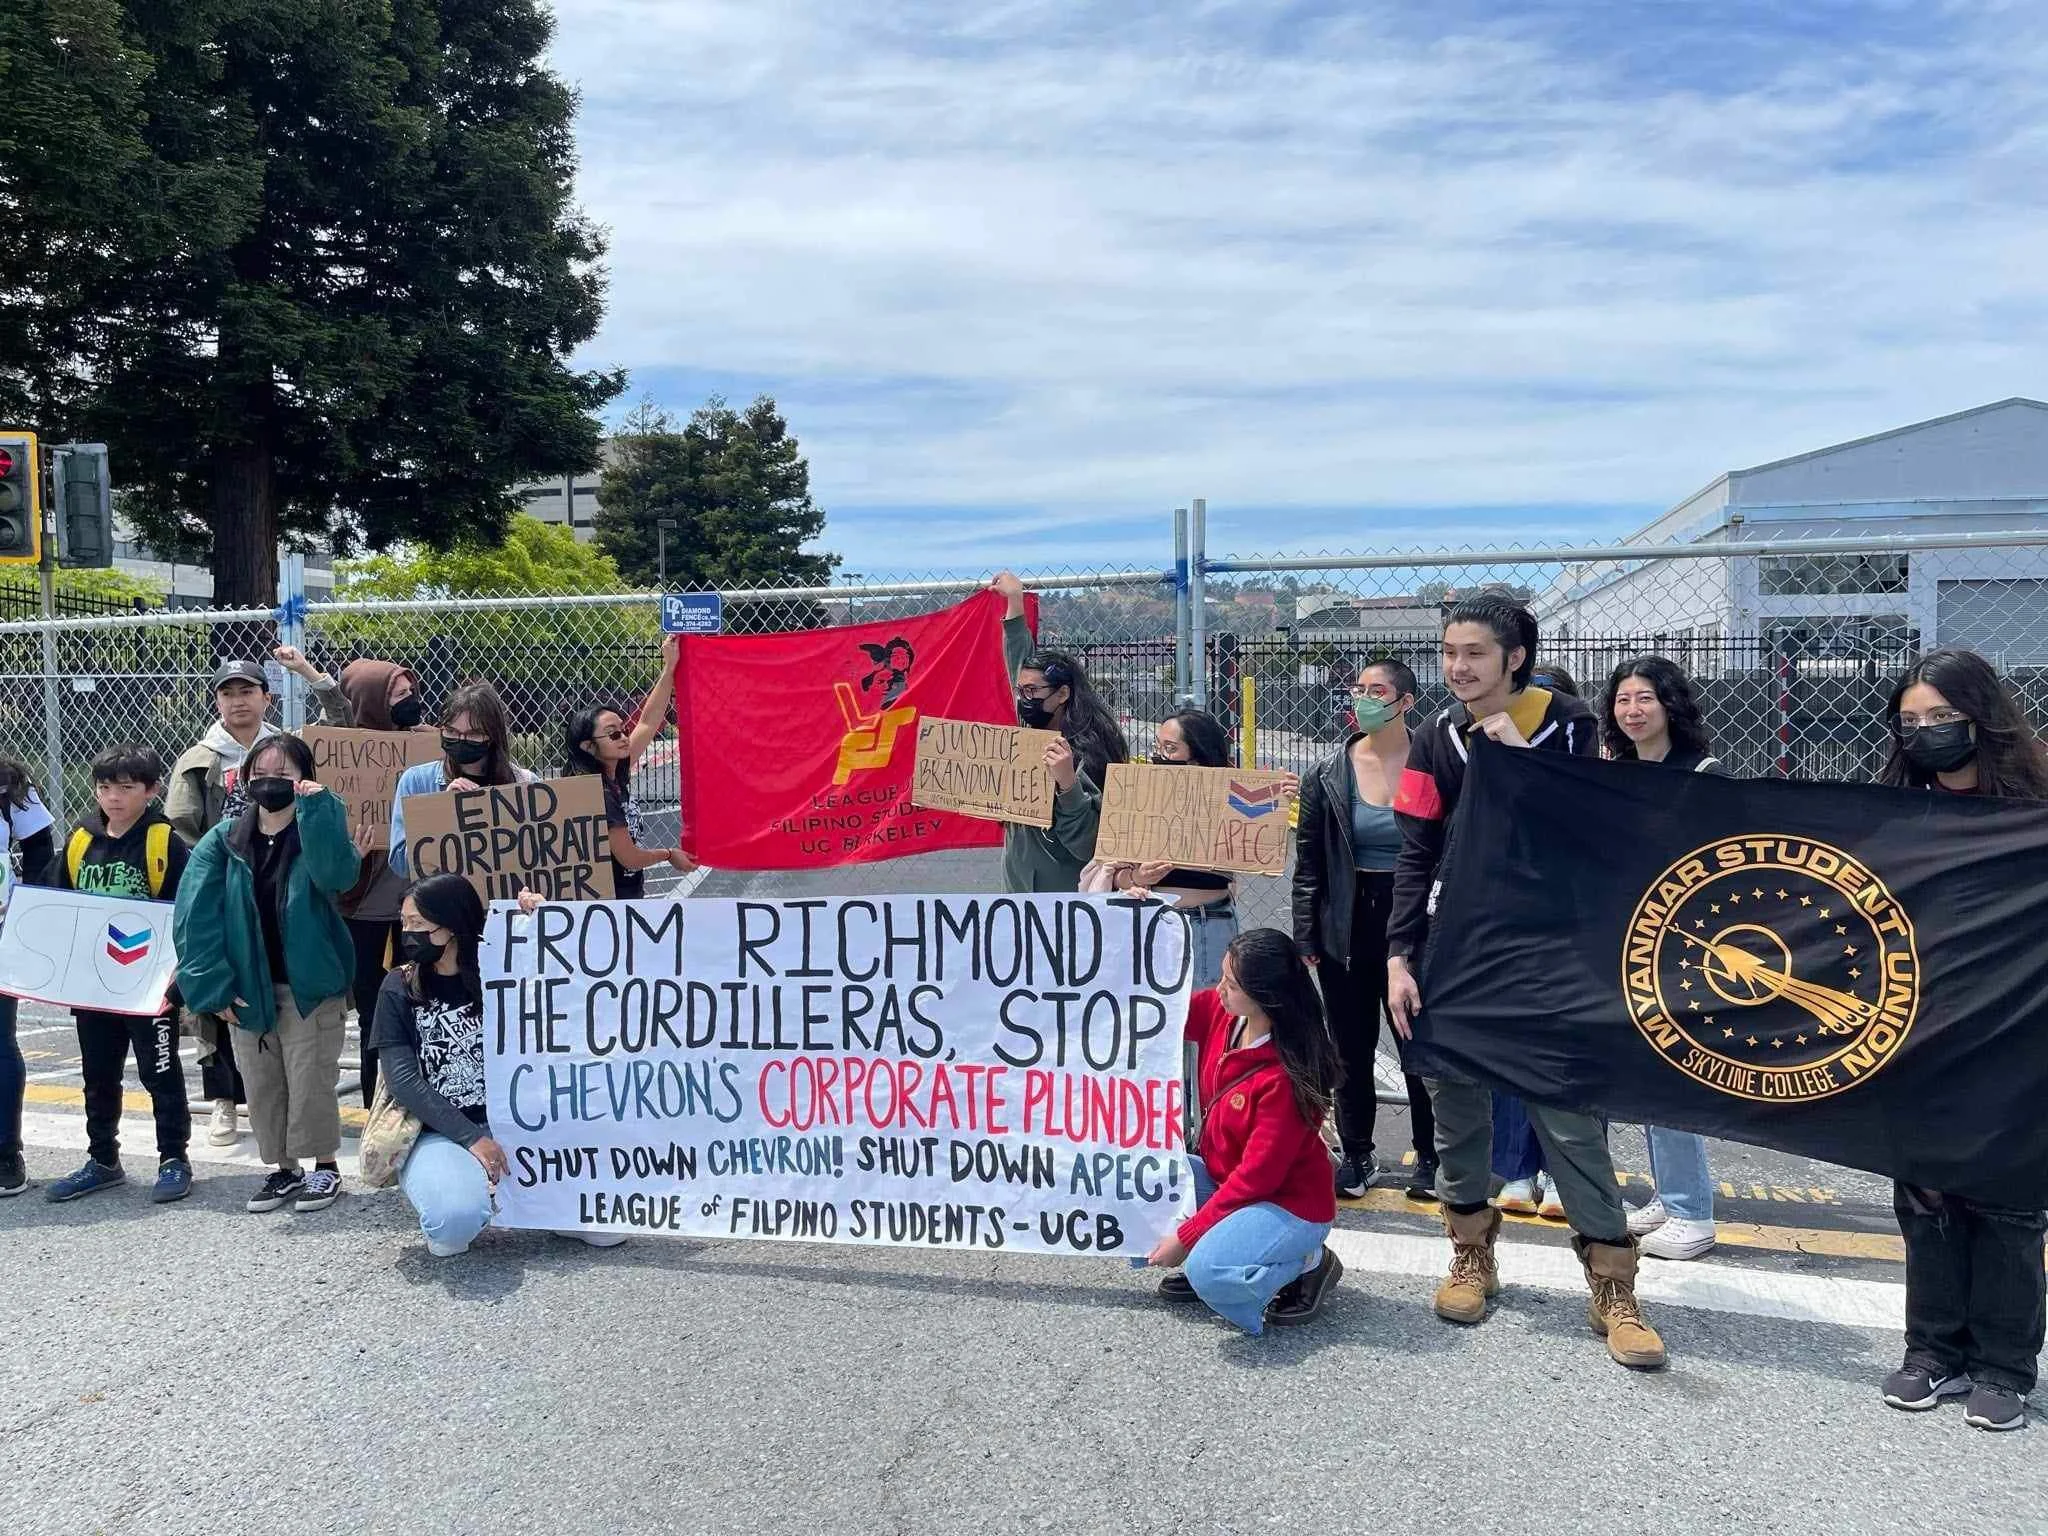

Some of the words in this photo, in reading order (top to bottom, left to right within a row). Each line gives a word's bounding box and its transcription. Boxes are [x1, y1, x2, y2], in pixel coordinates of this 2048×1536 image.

[681, 607, 712, 615] DIAMOND
[313, 738, 407, 769] CHEVRON
[936, 722, 1021, 764] JUSTICE
[812, 786, 900, 809] LEAGUE
[919, 758, 1004, 797] BRANDON
[1012, 765, 1049, 805] LEE!
[454, 782, 558, 832] END
[413, 813, 612, 882] CORPORATE
[801, 838, 833, 856] UC
[503, 902, 684, 976] FROM
[737, 898, 1103, 988] RICHMOND
[1105, 898, 1191, 995] TO
[1628, 858, 1711, 1051] MYANMAR
[1715, 840, 1909, 938] STUDENT
[1840, 951, 1913, 1079] UNION
[155, 1024, 170, 1073] Hurley
[485, 976, 571, 1055] THE
[586, 977, 957, 1062] CORDILLERAS,
[992, 989, 1167, 1072] STOP
[1681, 1047, 1756, 1094] SKYLINE
[1761, 1065, 1840, 1098] COLLEGE
[509, 1056, 743, 1132] CHEVRON'S
[758, 1056, 1009, 1134] CORPORATE
[1023, 1069, 1184, 1151] PLUNDER
[516, 1146, 598, 1188] SHUT
[610, 1142, 698, 1181] DOWN
[707, 1135, 843, 1178] CHEVRON!
[856, 1136, 939, 1178] SHUT
[950, 1140, 1056, 1189] DOWN
[1070, 1152, 1181, 1202] APEC!
[579, 1192, 681, 1230] LEAGUE
[700, 1195, 722, 1218] of
[729, 1198, 839, 1239] FILPINO
[849, 1199, 1006, 1248] STUDENTS
[1039, 1209, 1125, 1252] UCB
